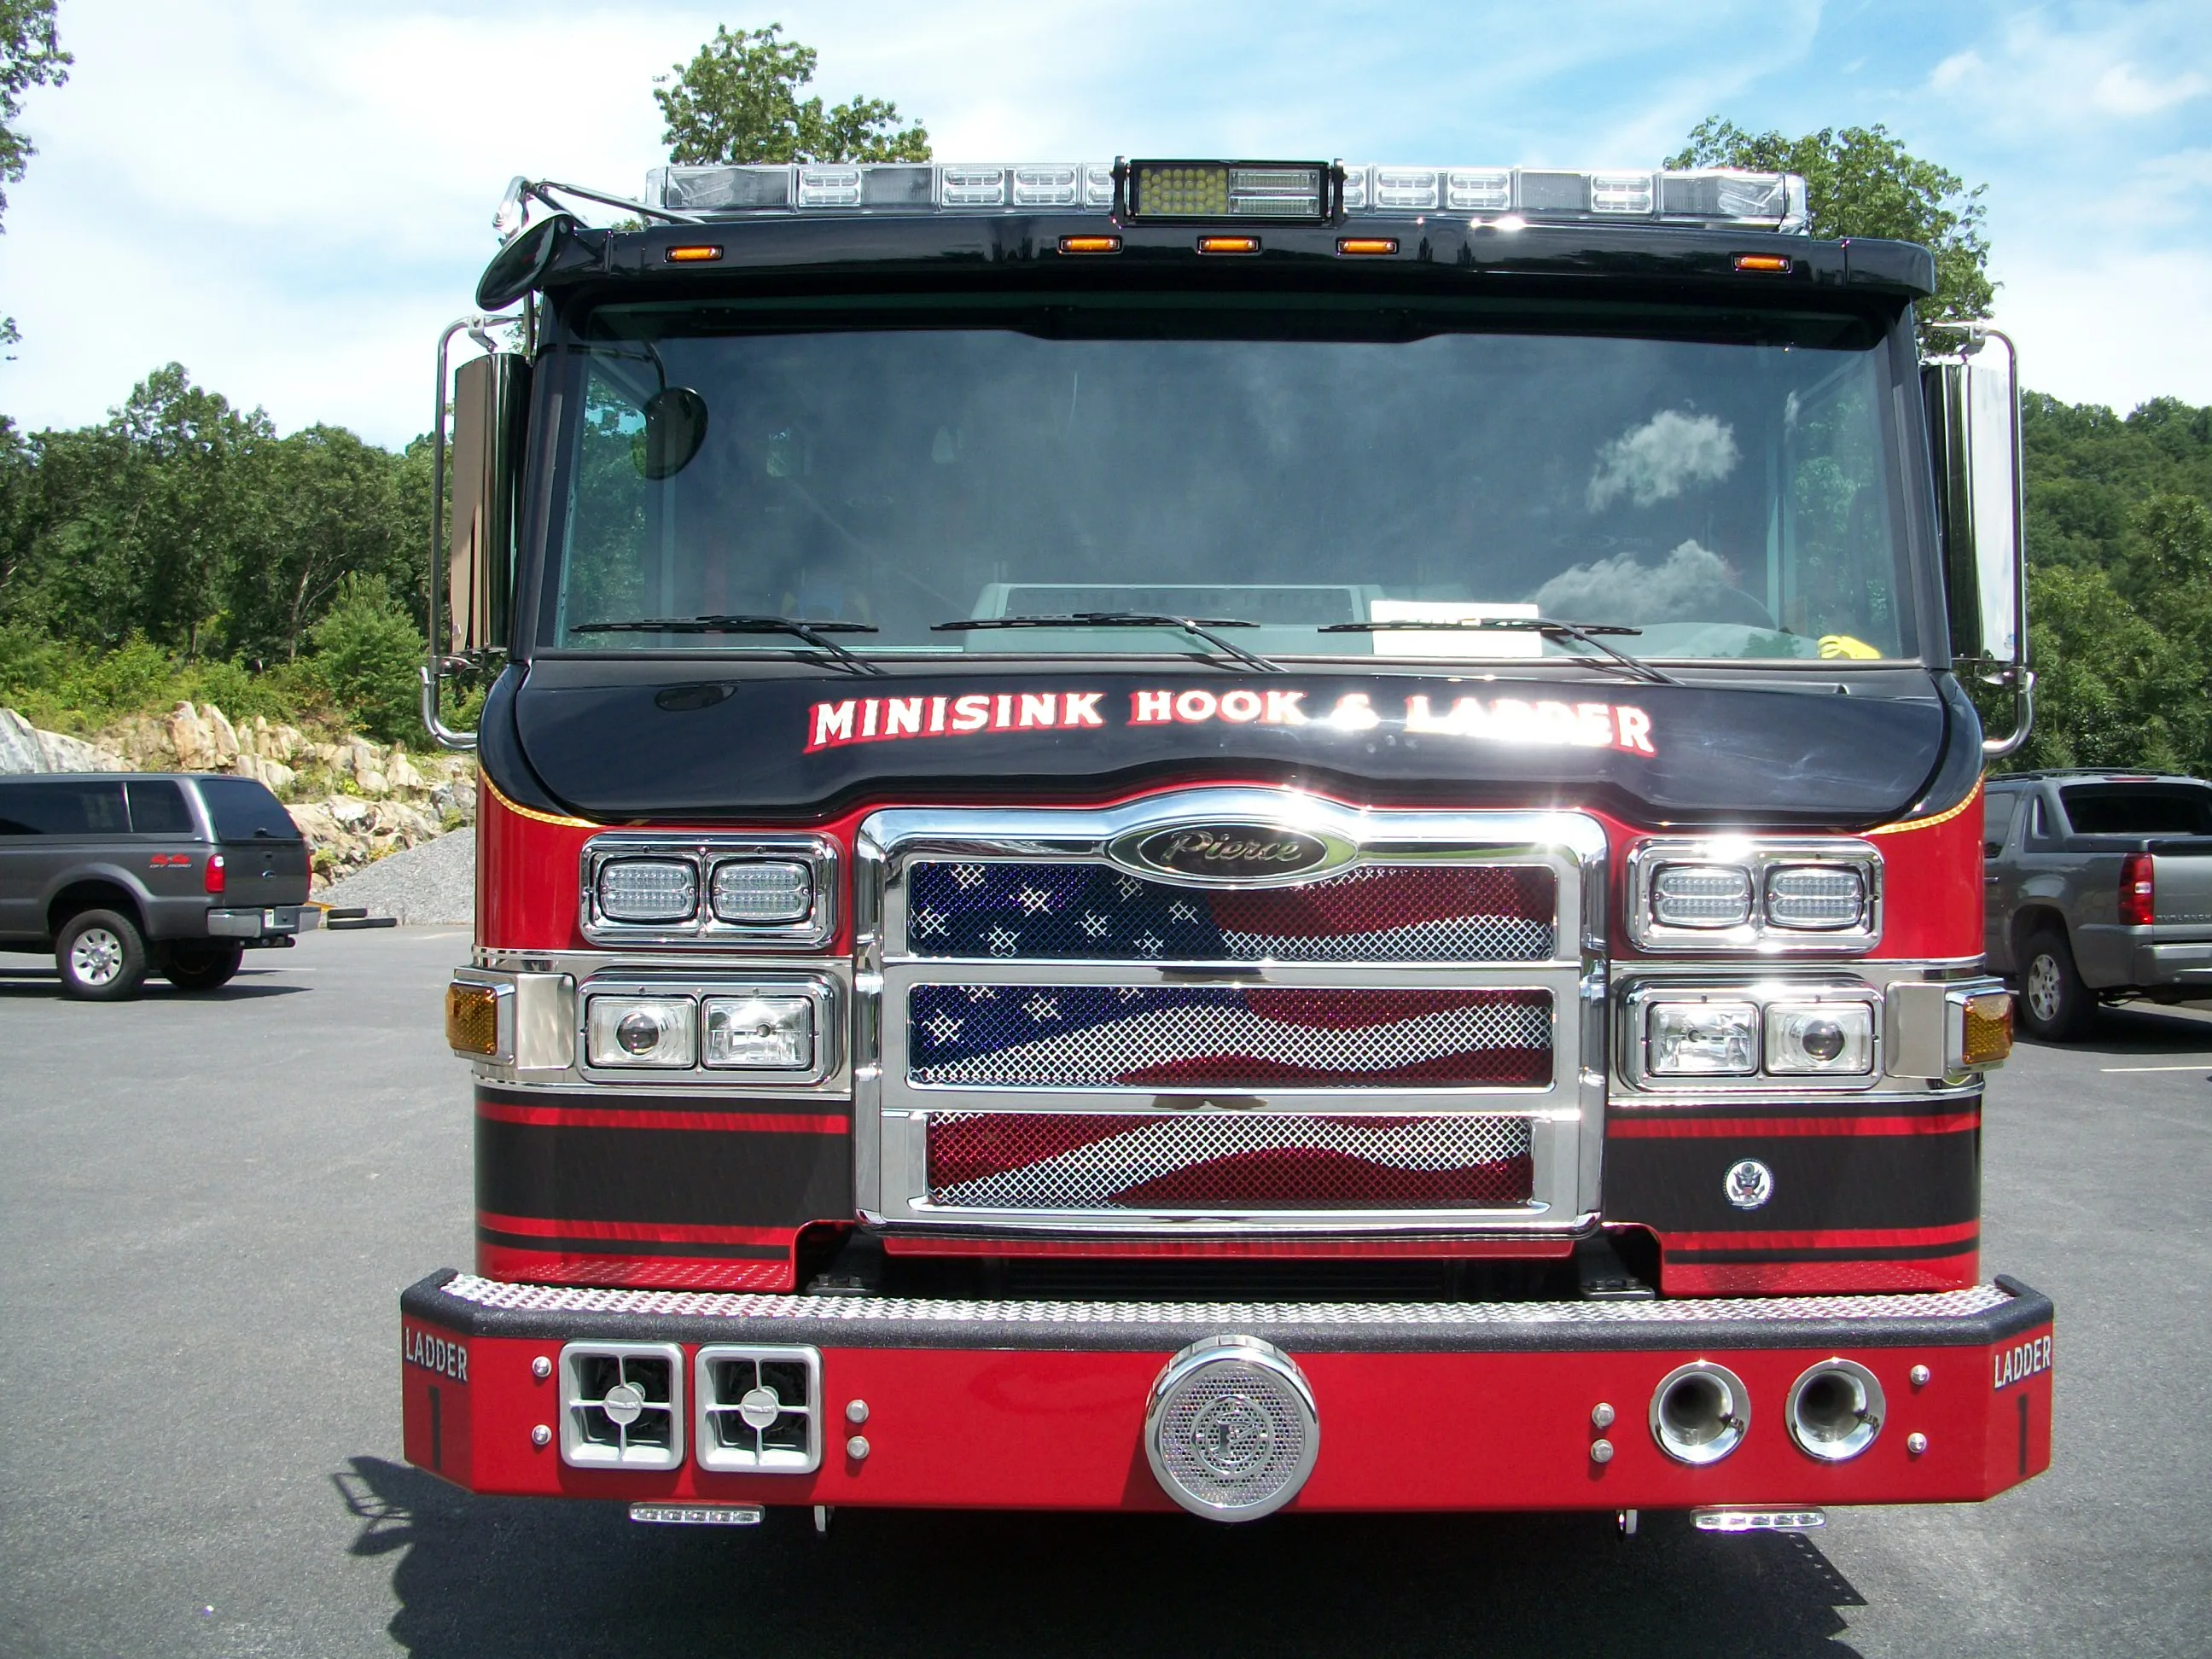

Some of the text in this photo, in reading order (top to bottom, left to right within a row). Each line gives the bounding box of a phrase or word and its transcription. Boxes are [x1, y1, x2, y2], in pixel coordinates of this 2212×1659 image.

[804, 690, 1656, 758] MINISINK HOOK & LADDER
[1161, 831, 1302, 864] Pierce
[405, 1325, 469, 1382] LADDER
[1994, 1335, 2052, 1389] LADDER
[429, 1386, 441, 1470] 1
[2018, 1394, 2027, 1476] 1
